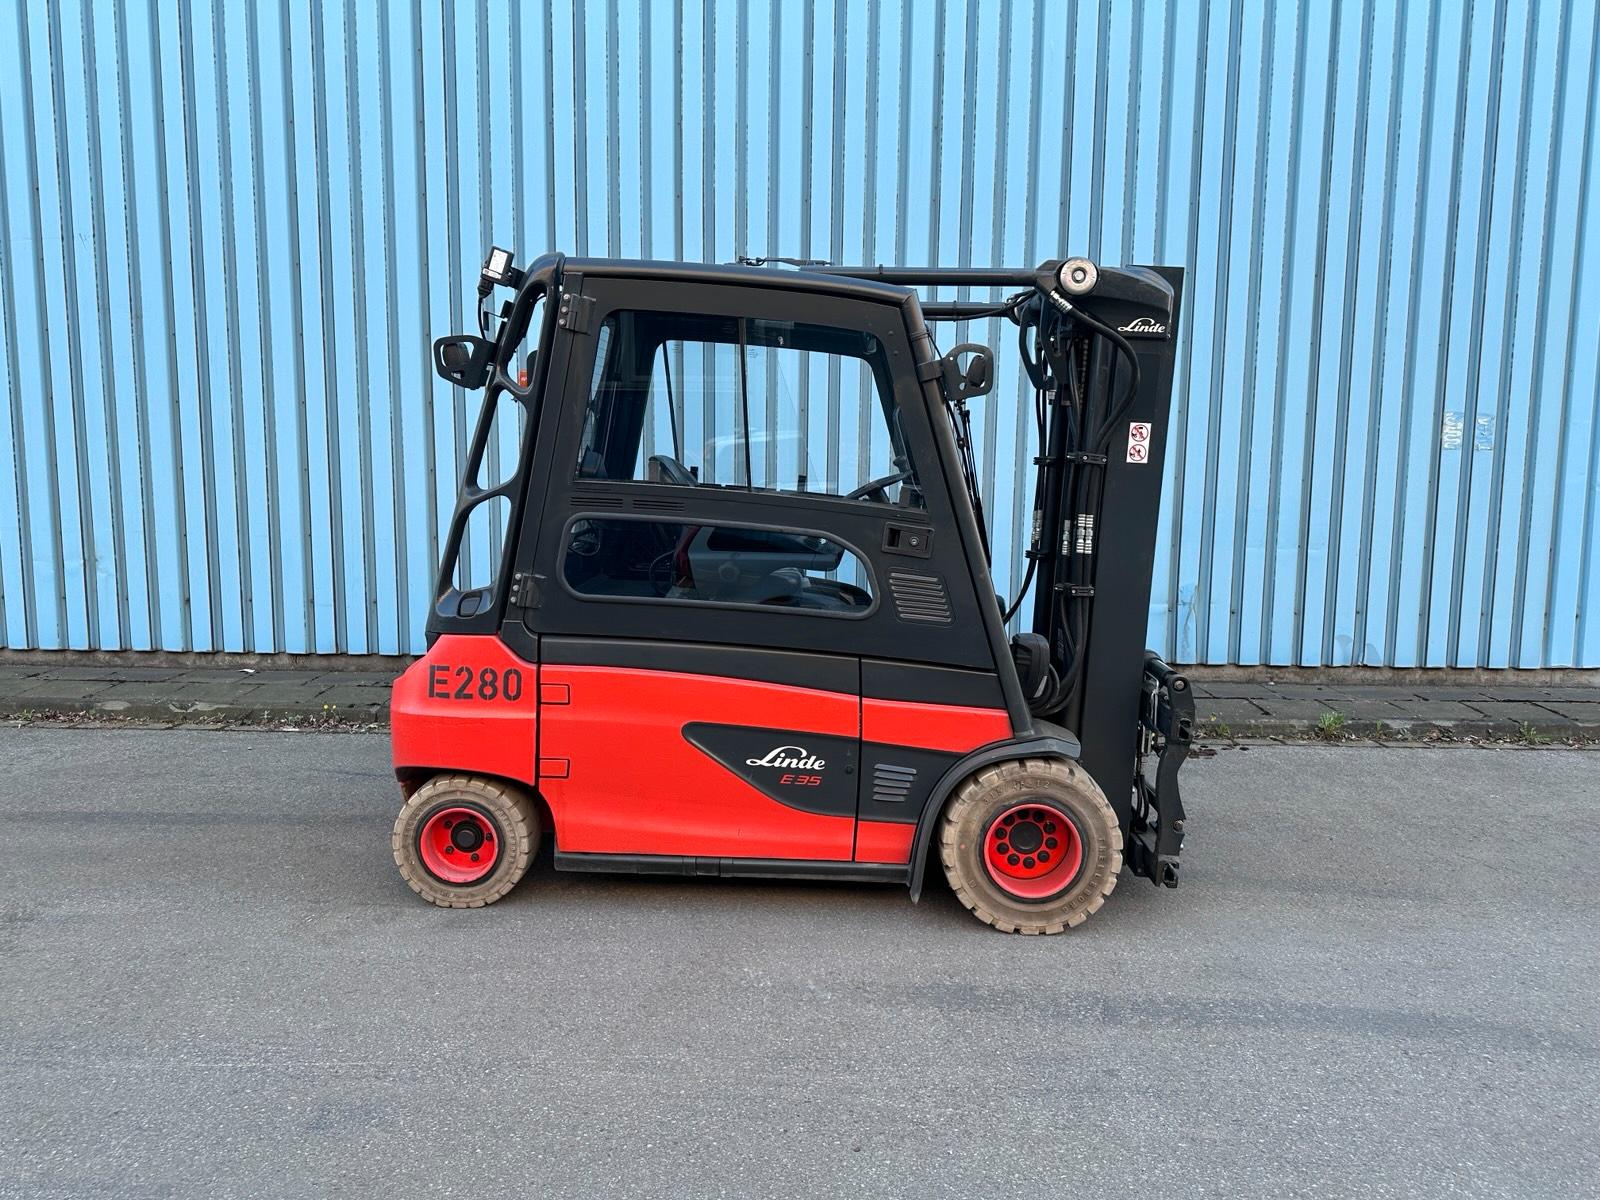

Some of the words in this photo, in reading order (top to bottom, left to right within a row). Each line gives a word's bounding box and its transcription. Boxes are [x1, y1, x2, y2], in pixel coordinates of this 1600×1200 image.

[1117, 317, 1166, 333] Linde
[428, 664, 522, 701] E280
[745, 745, 826, 770] Linde
[780, 774, 795, 784] E
[794, 775, 823, 786] 35
